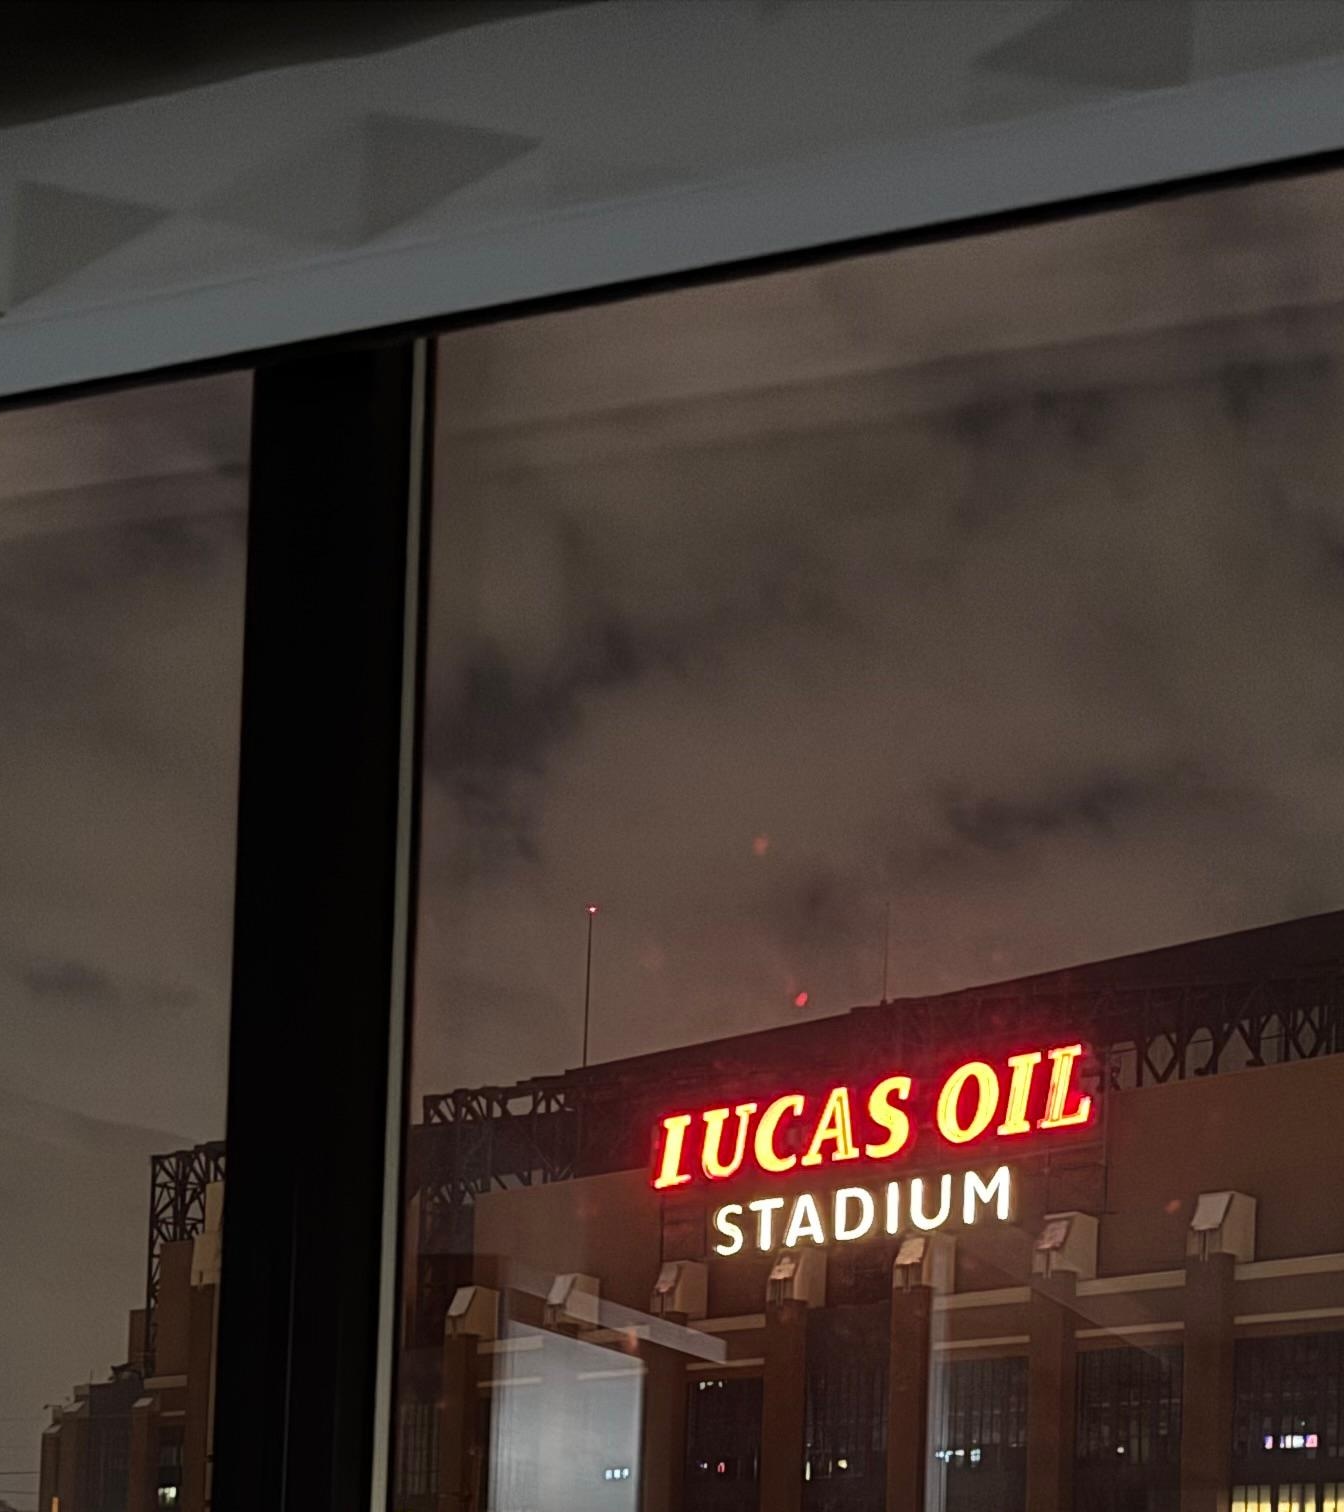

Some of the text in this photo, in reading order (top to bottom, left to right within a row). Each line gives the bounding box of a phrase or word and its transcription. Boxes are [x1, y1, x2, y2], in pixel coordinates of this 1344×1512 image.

[654, 1044, 1091, 1189] LUCAS OIL
[716, 1166, 1010, 1256] STADIUM
